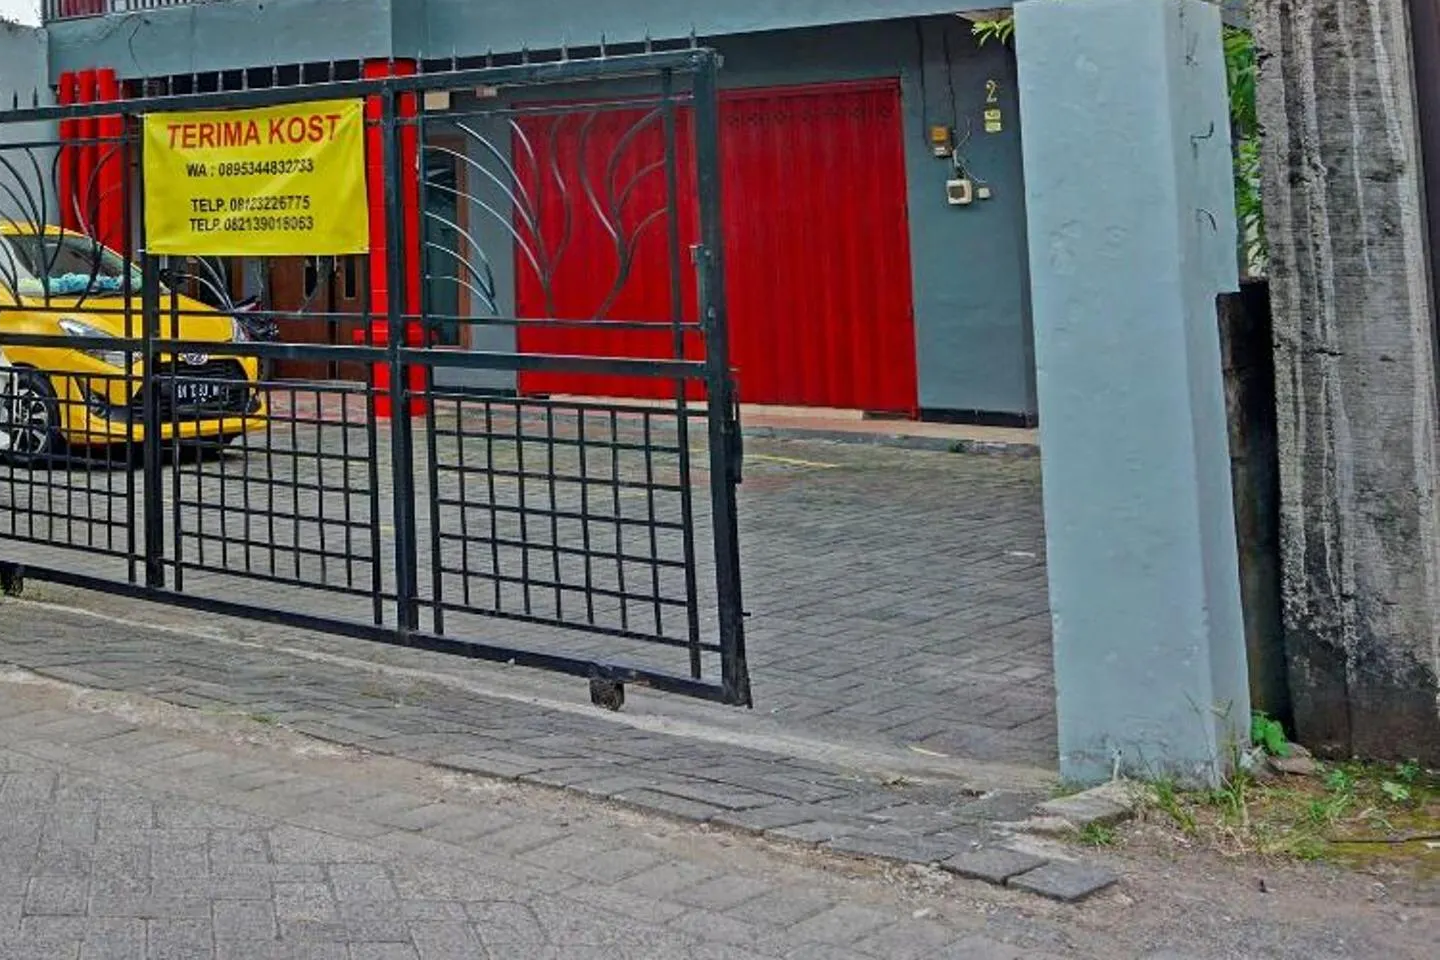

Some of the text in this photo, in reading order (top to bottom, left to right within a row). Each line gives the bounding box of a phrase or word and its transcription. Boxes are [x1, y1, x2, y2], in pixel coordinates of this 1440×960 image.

[986, 79, 997, 102] 2
[168, 115, 341, 149] TERIMA KOST
[187, 164, 207, 177] WA
[192, 198, 227, 212] TELP.
